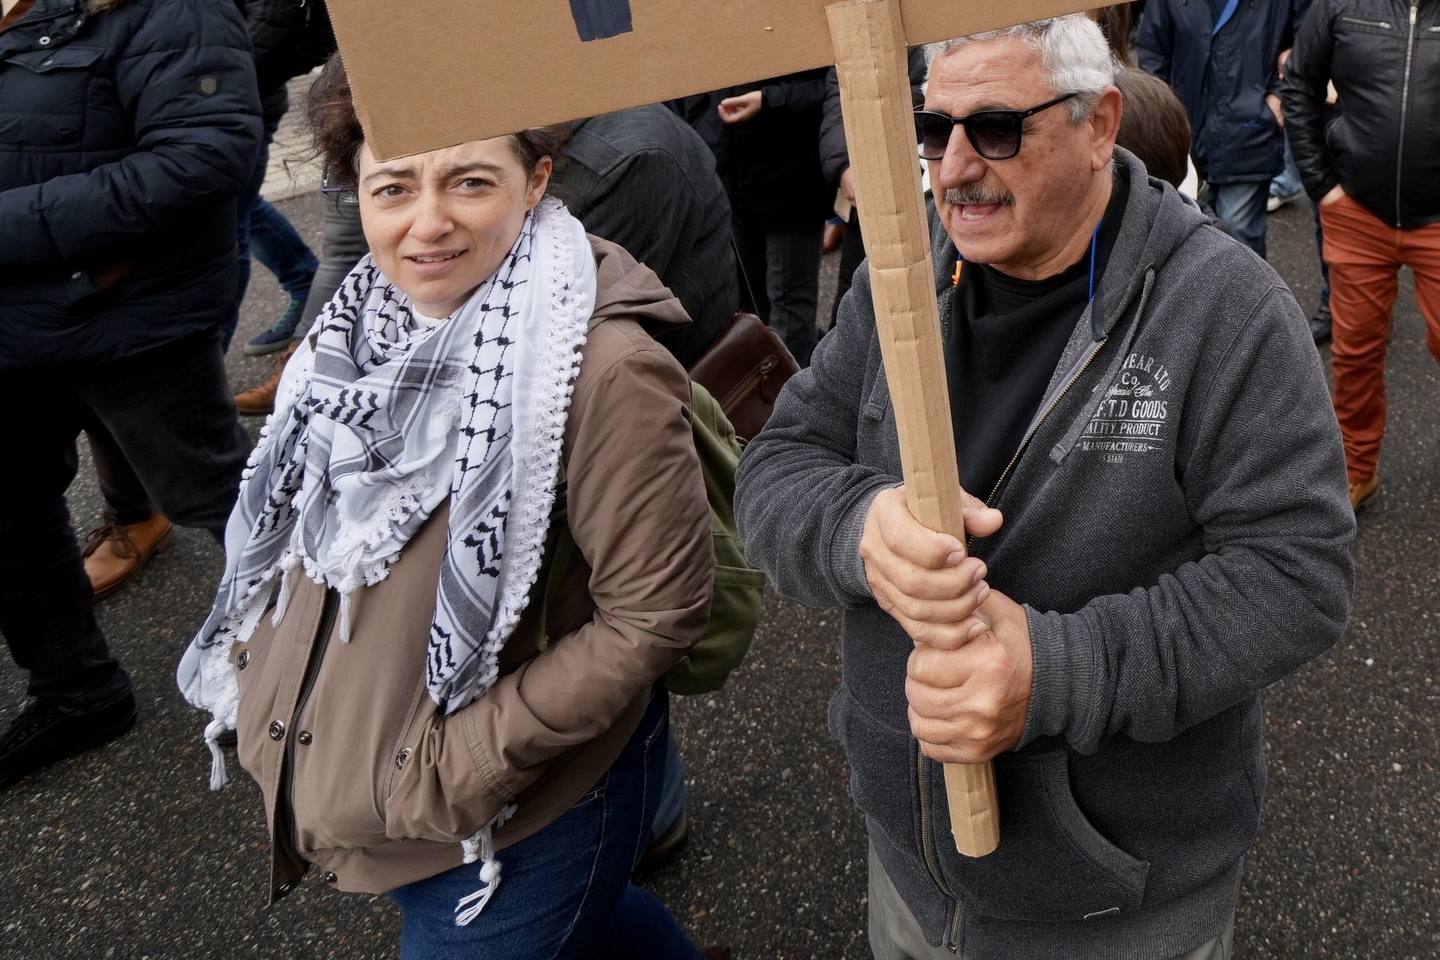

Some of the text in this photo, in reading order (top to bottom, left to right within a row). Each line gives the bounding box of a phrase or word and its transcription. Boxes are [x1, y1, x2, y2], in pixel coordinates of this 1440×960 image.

[1154, 364, 1171, 391] LTD
[1131, 400, 1168, 419] GOODS
[1119, 422, 1161, 436] PRODUCT
[1081, 441, 1149, 452] MANUFACTURERS
